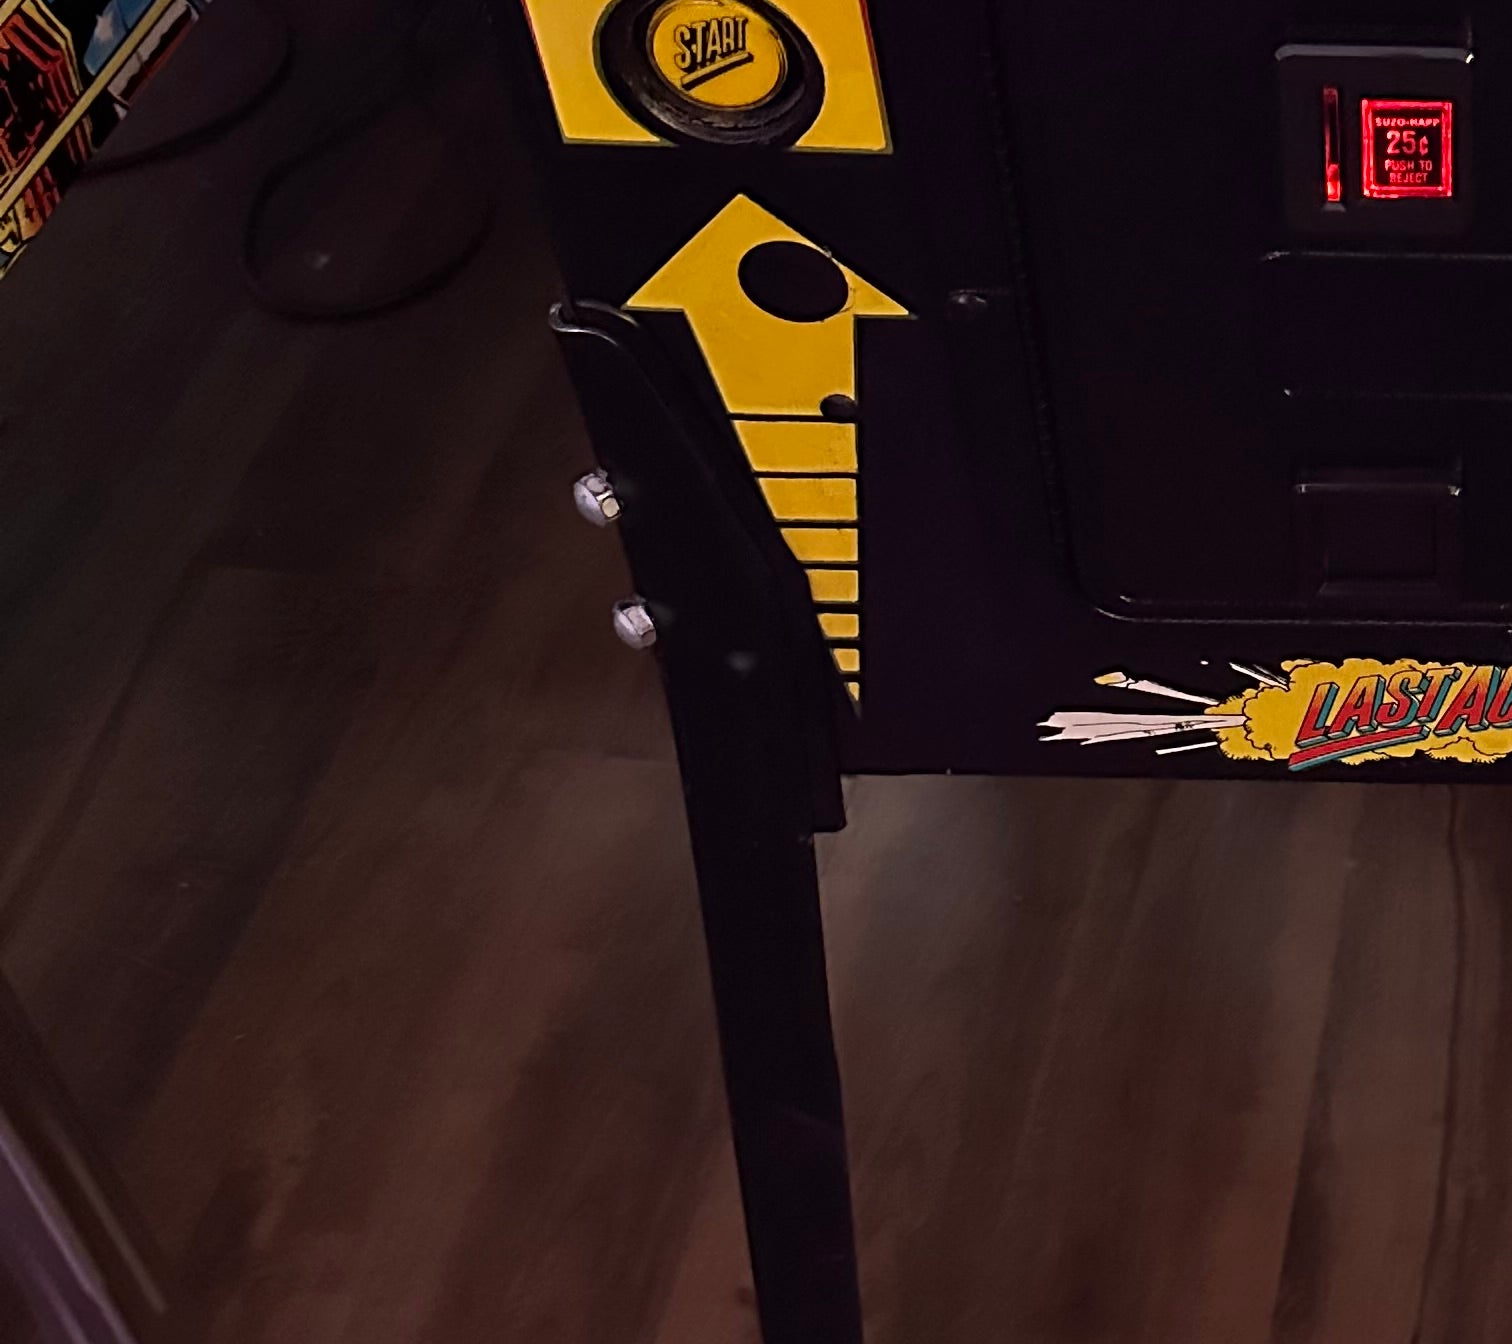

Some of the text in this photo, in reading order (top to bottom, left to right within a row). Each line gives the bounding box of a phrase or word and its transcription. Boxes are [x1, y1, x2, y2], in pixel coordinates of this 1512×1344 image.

[673, 16, 750, 70] START
[1386, 130, 1429, 156] 25¢
[1384, 159, 1433, 172] PUSH TO
[1389, 172, 1428, 184] REJECT
[1296, 666, 1461, 748] LAST
